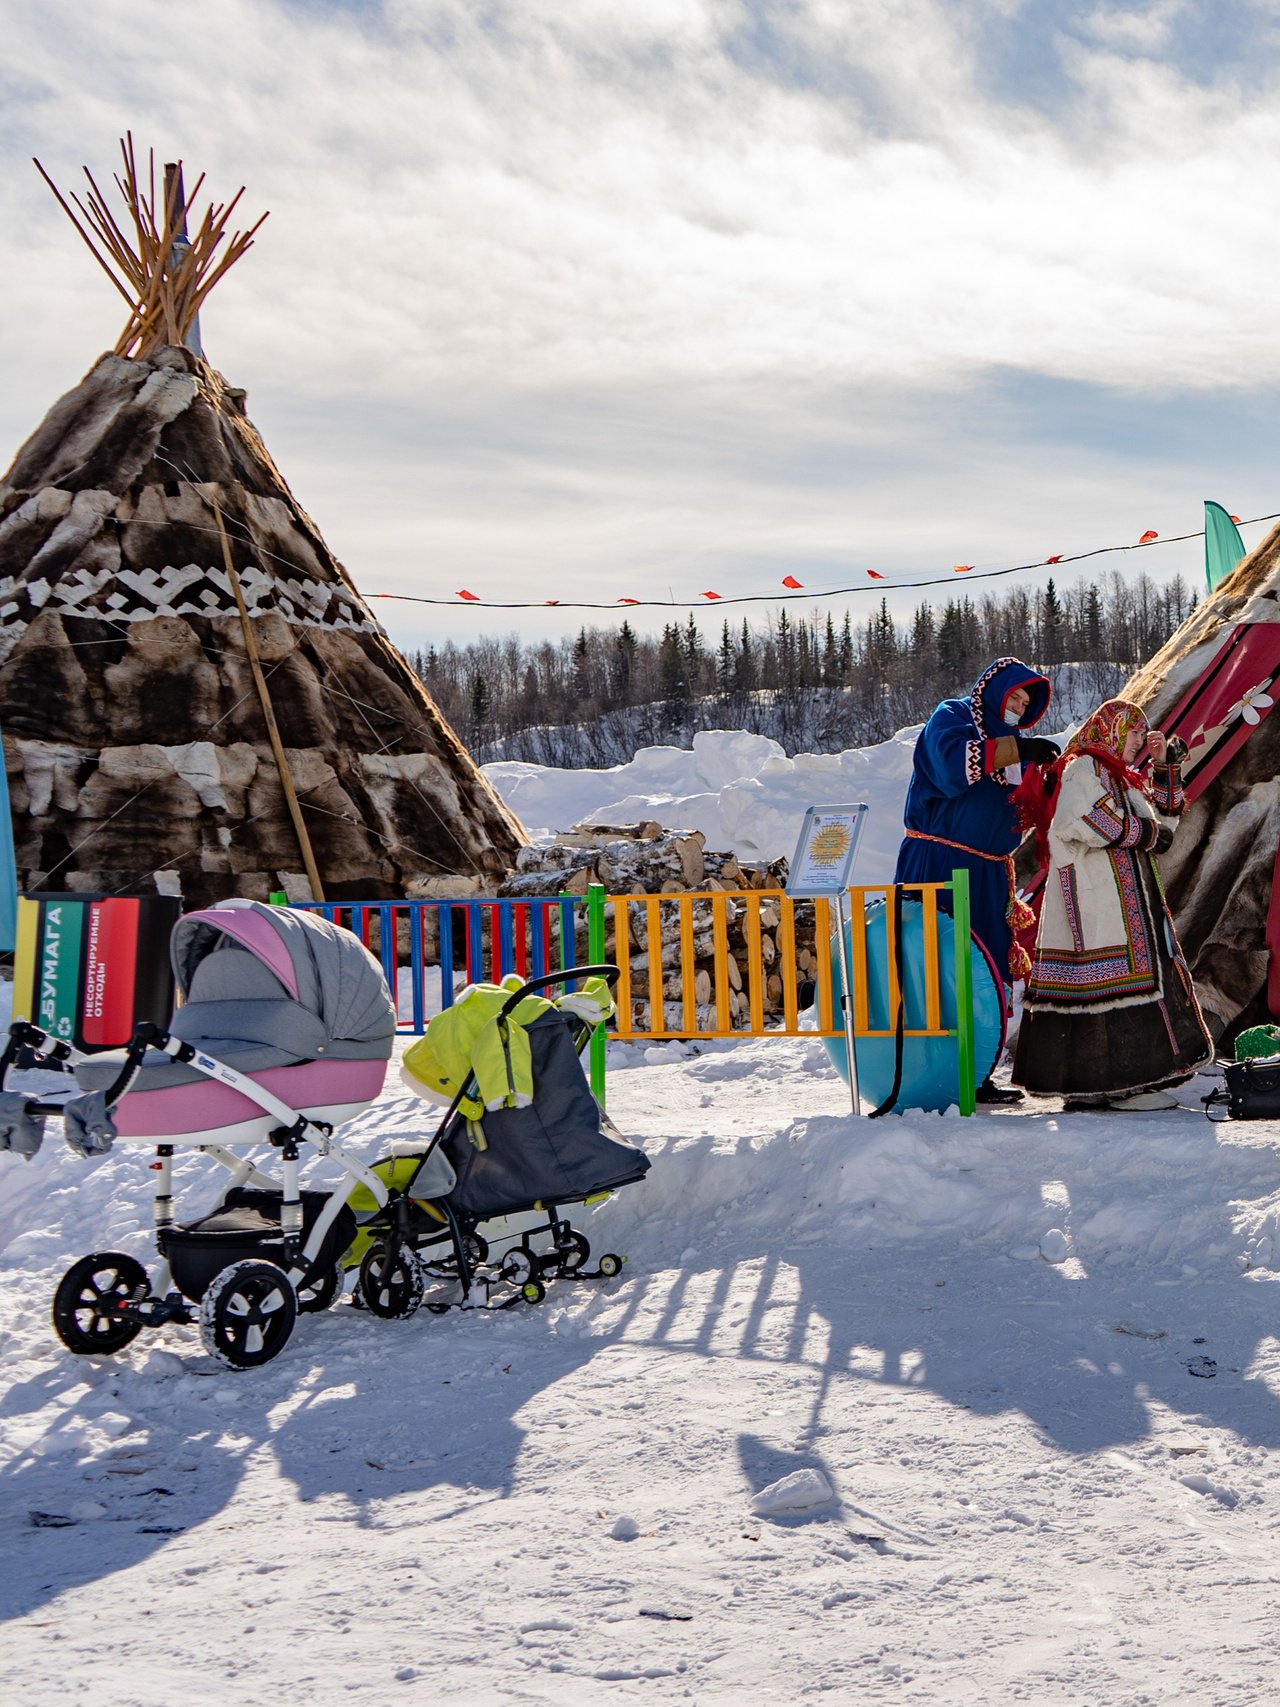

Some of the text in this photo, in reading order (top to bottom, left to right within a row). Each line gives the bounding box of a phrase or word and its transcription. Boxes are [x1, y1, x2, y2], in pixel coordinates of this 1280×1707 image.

[41, 907, 62, 1017] БУМАГА
[86, 908, 100, 1018] НЕСОРТИРУЕМЫЕ
[94, 963, 106, 1018] ОТХОДЫ
